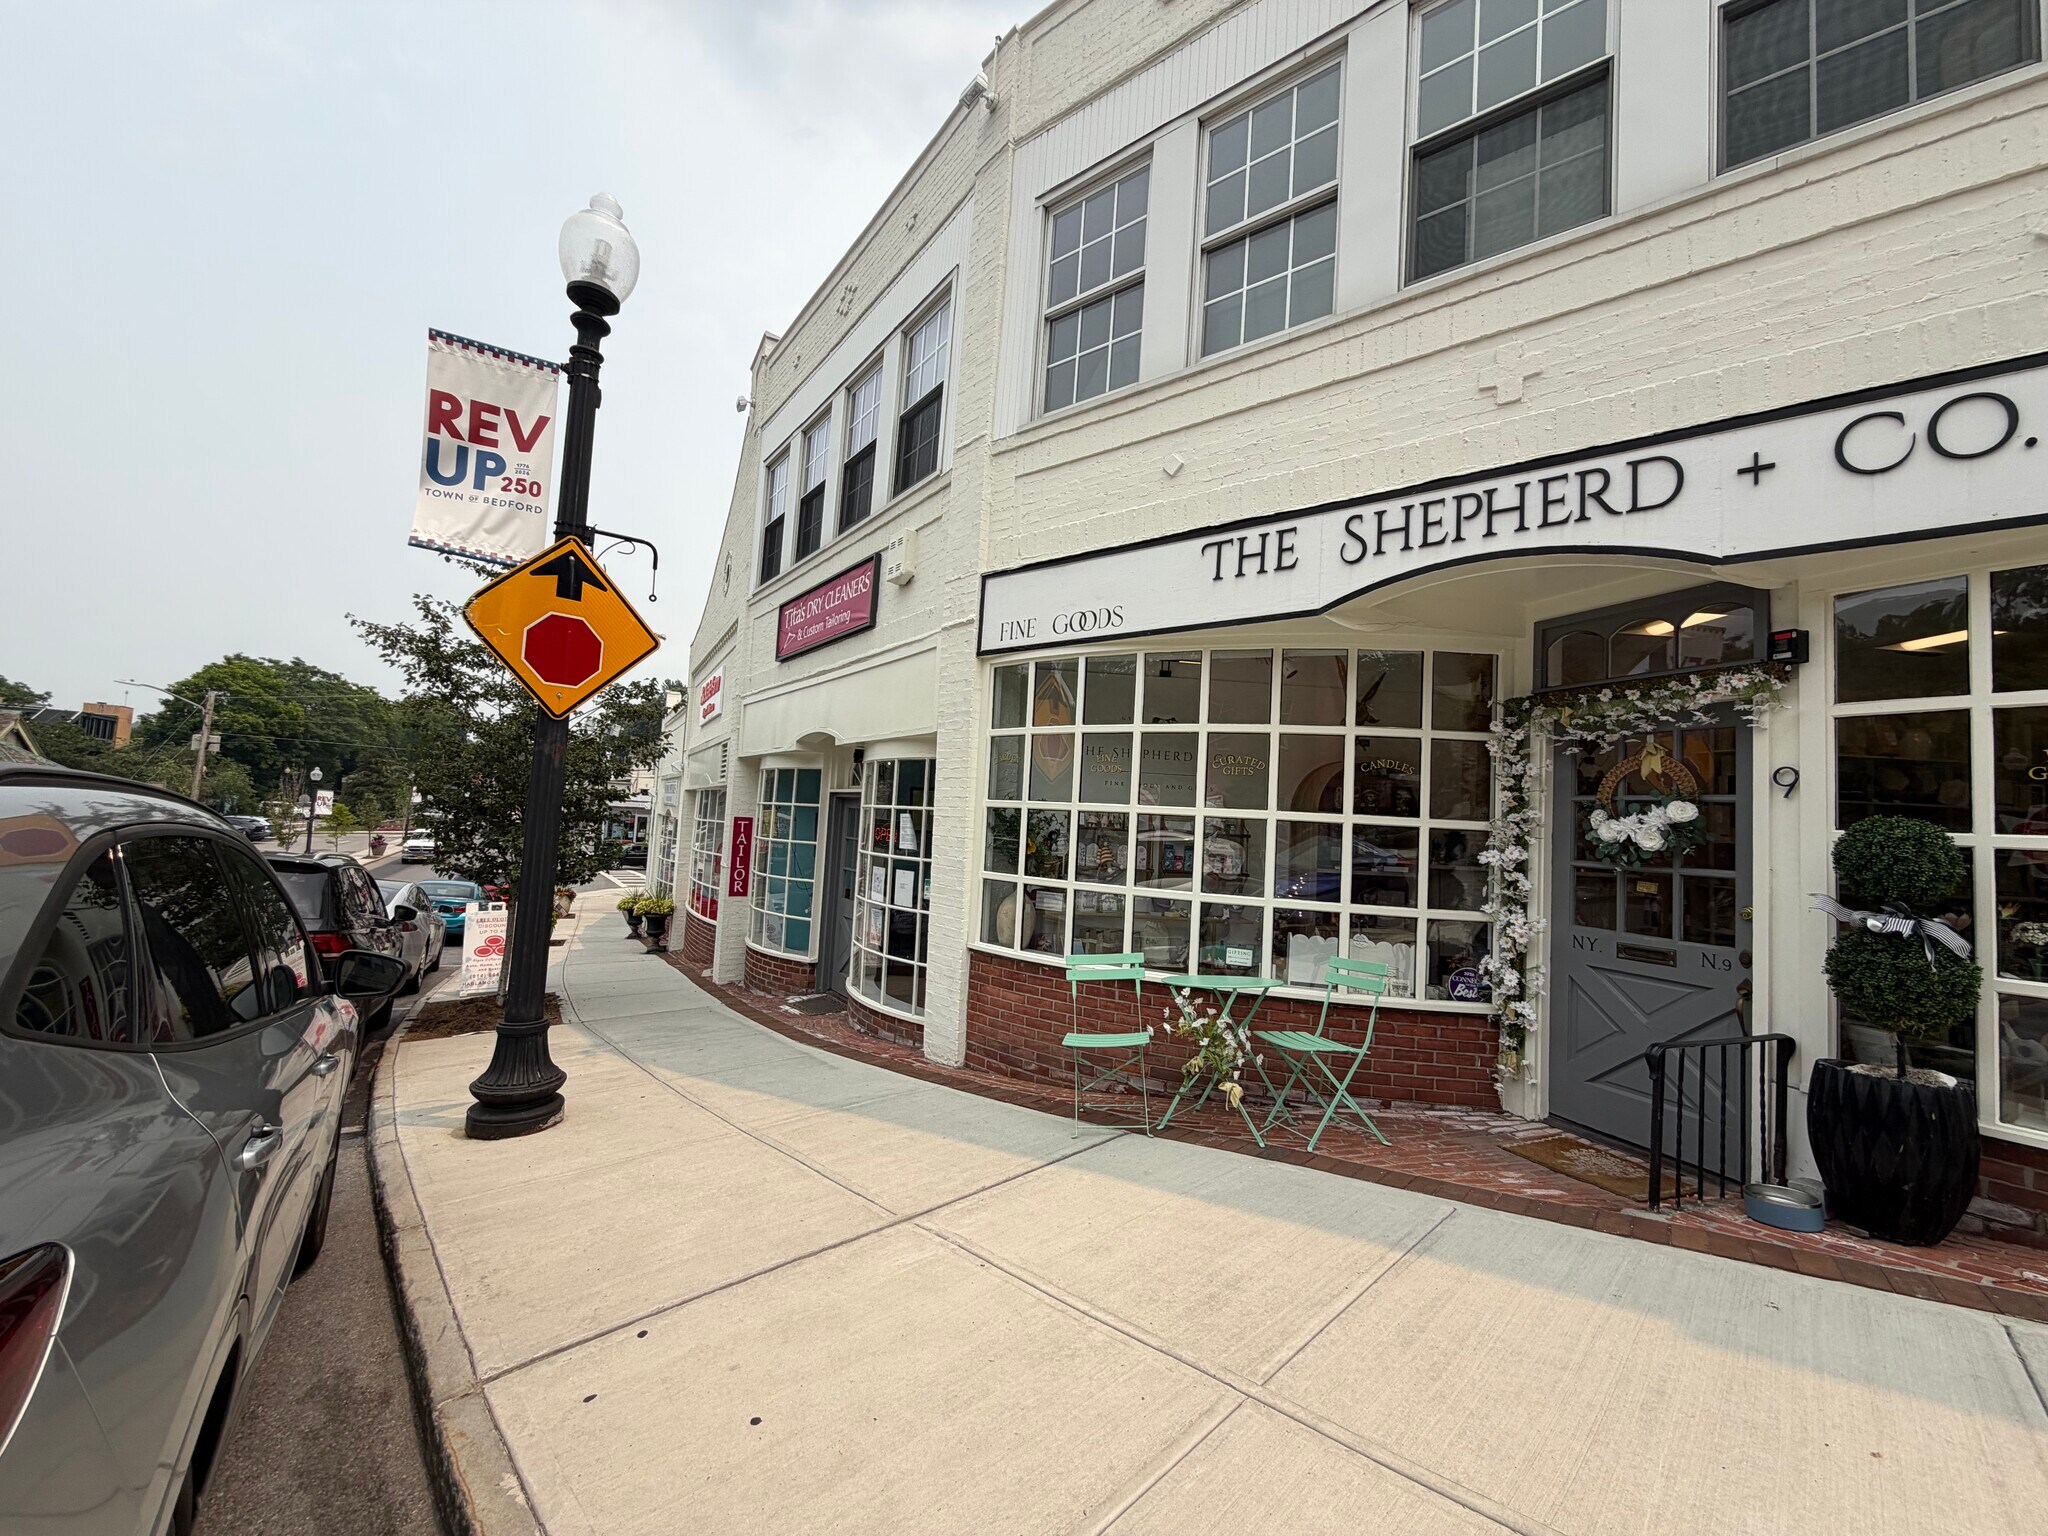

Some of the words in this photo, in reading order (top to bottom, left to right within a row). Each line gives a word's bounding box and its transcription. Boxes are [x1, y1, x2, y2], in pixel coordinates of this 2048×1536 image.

[428, 388, 551, 453] REV
[425, 437, 507, 491] UP
[500, 477, 542, 497] 250
[1201, 526, 1299, 581] THE
[1340, 455, 1685, 565] SHEPHERD
[1834, 391, 2039, 475] CO.
[425, 488, 464, 500] TOWN
[483, 497, 543, 514] BEDFORD
[784, 602, 806, 629] Tita's
[807, 595, 825, 619] DRY
[824, 571, 871, 610] CLEANERS
[797, 629, 803, 641] &
[802, 621, 824, 638] Custom
[825, 610, 851, 629] Tailoring
[1000, 617, 1038, 642] FINE
[1052, 605, 1124, 635] GOODS
[1097, 755, 1118, 763] FINE
[1113, 747, 1193, 762] SHPHERD
[1212, 755, 1266, 770] CURATED
[1090, 764, 1123, 773] GOODS
[1222, 766, 1254, 776] GIFTS
[1360, 759, 1415, 774] CANDLES
[1773, 766, 1800, 798] 9
[733, 820, 750, 893] TAILOR
[1572, 934, 1602, 953] NY.
[1454, 983, 1478, 998] Best
